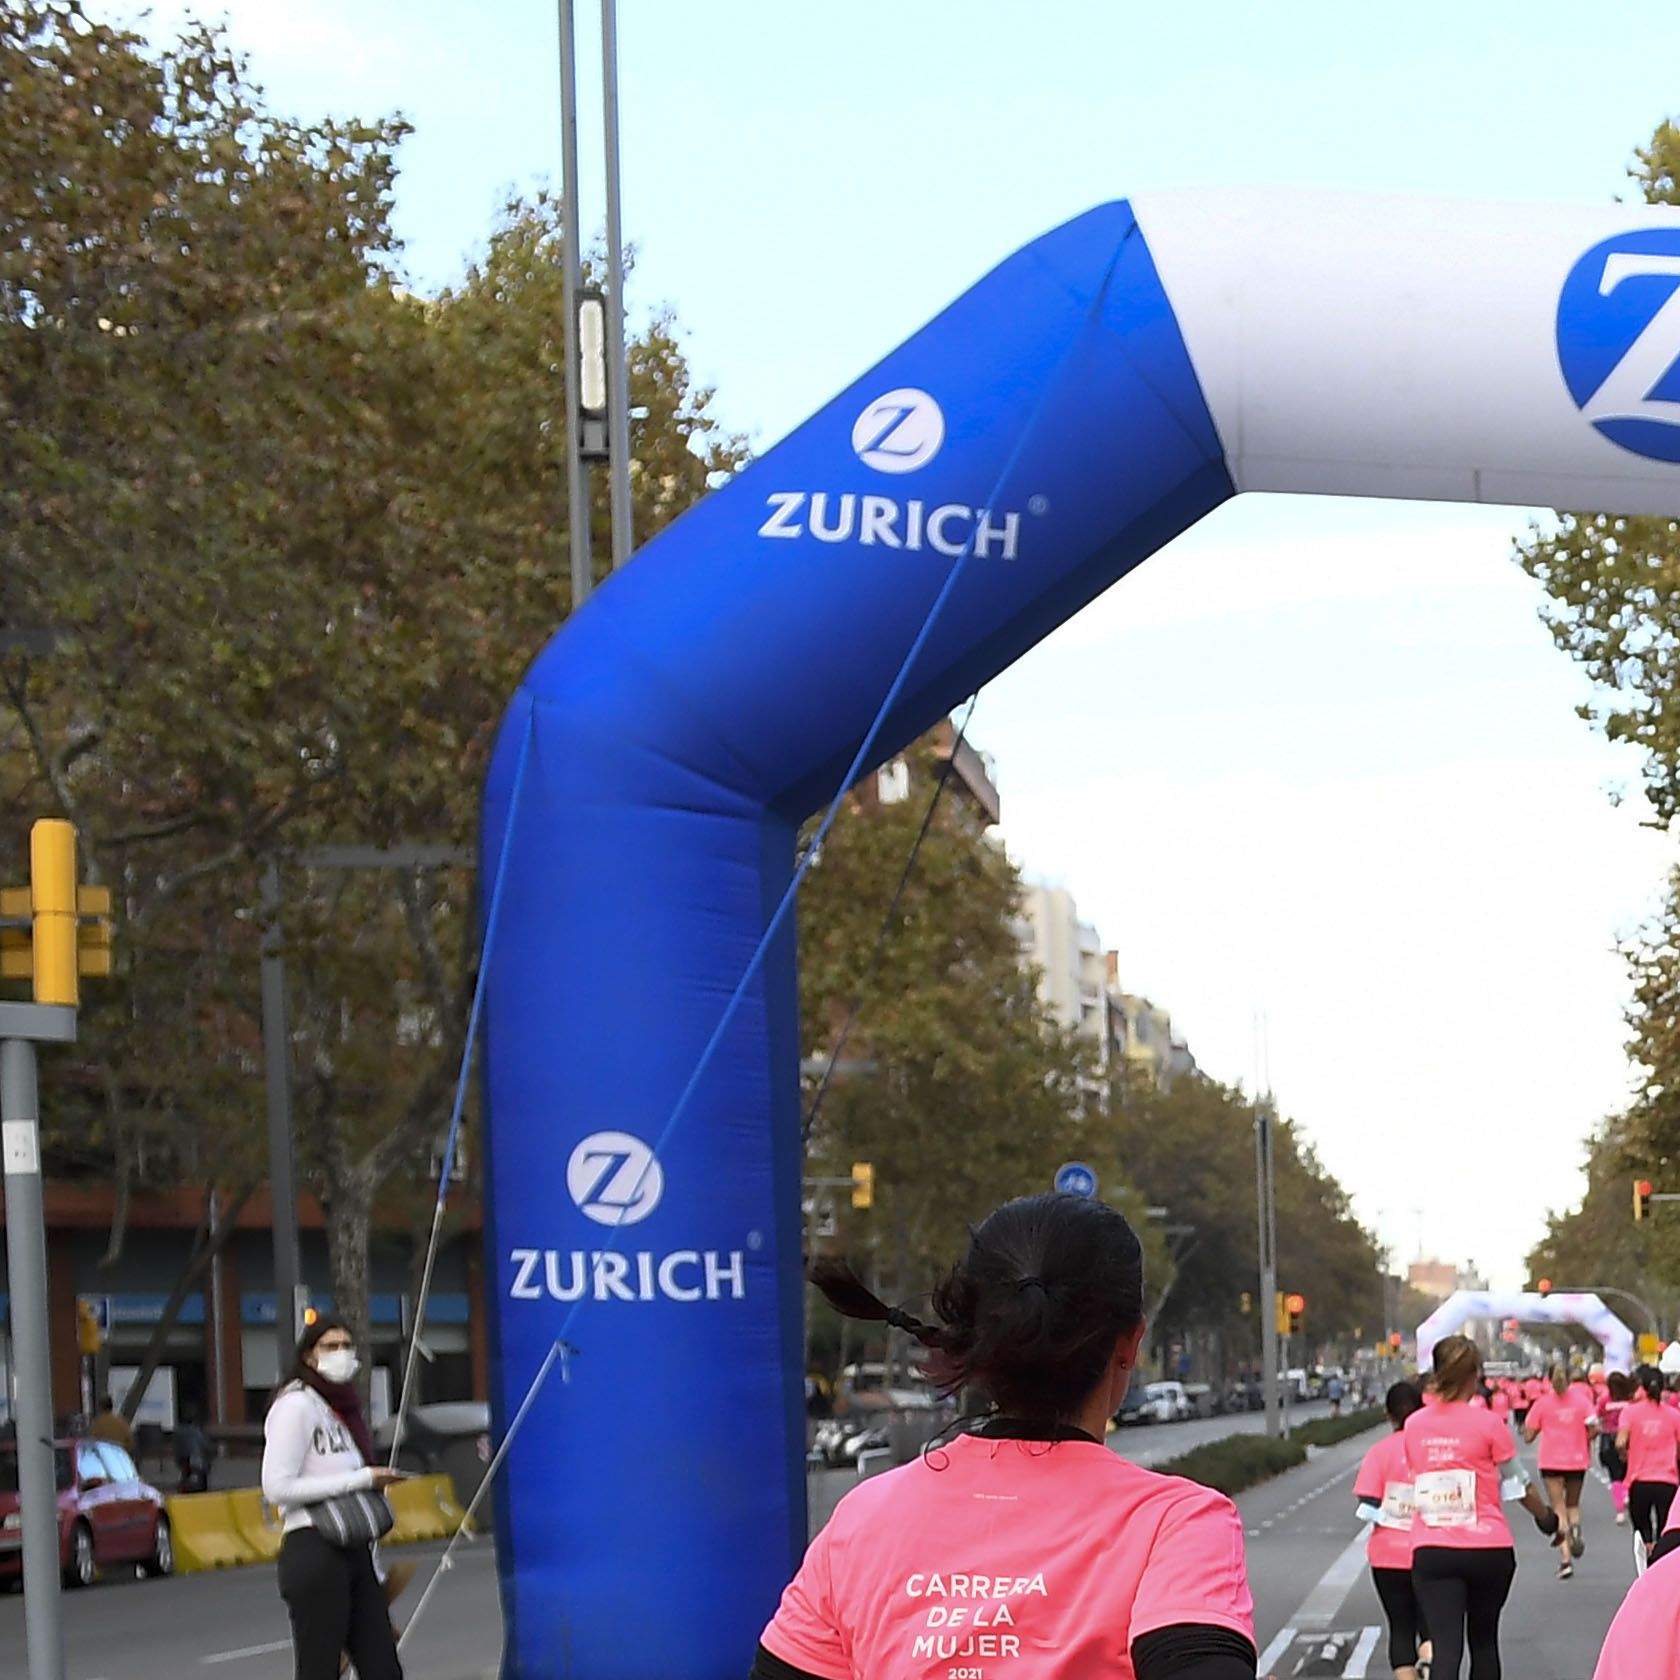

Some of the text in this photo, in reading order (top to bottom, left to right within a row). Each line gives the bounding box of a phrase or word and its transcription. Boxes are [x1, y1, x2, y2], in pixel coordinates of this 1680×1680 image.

[757, 491, 1021, 561] ZURICH
[509, 1248, 745, 1301] ZURICH
[906, 1573, 1048, 1598] CARRERA
[926, 1604, 1014, 1627] DE LA
[911, 1635, 1020, 1658] MUJER
[949, 1668, 982, 1680] 2021
